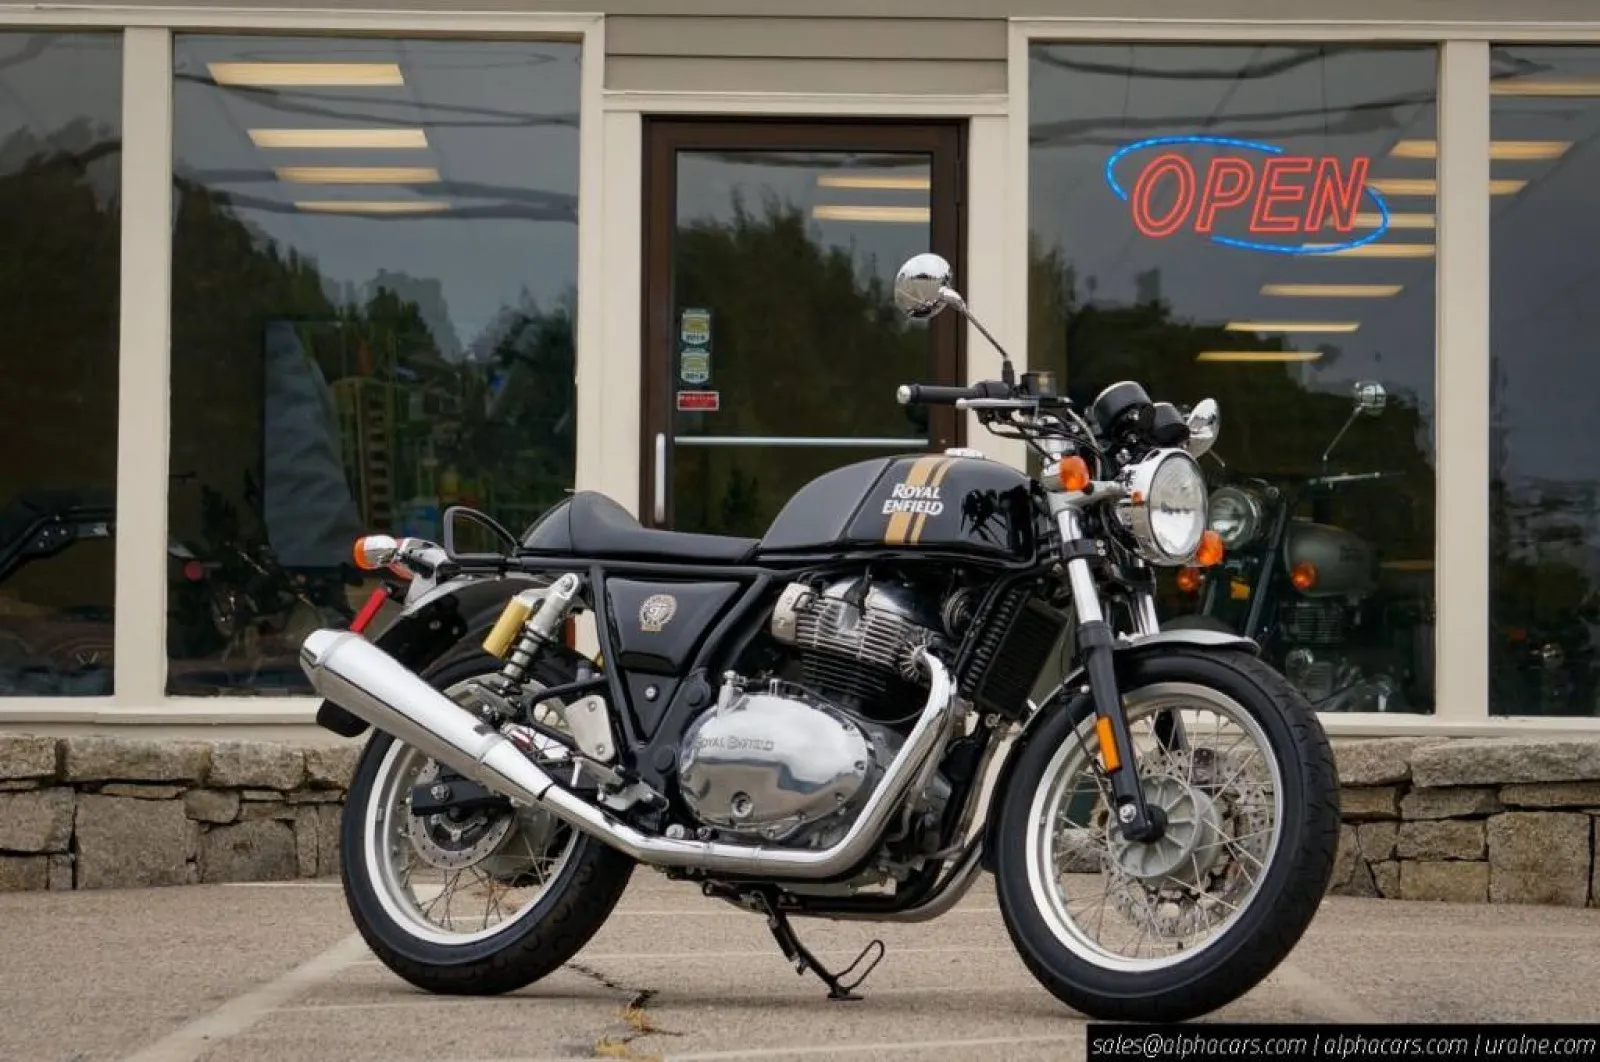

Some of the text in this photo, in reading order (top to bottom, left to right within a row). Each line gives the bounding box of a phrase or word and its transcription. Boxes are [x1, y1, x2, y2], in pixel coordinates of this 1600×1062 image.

[1131, 153, 1370, 238] OPEN
[891, 483, 941, 499] ROYAL
[881, 499, 944, 516] ENFIELD
